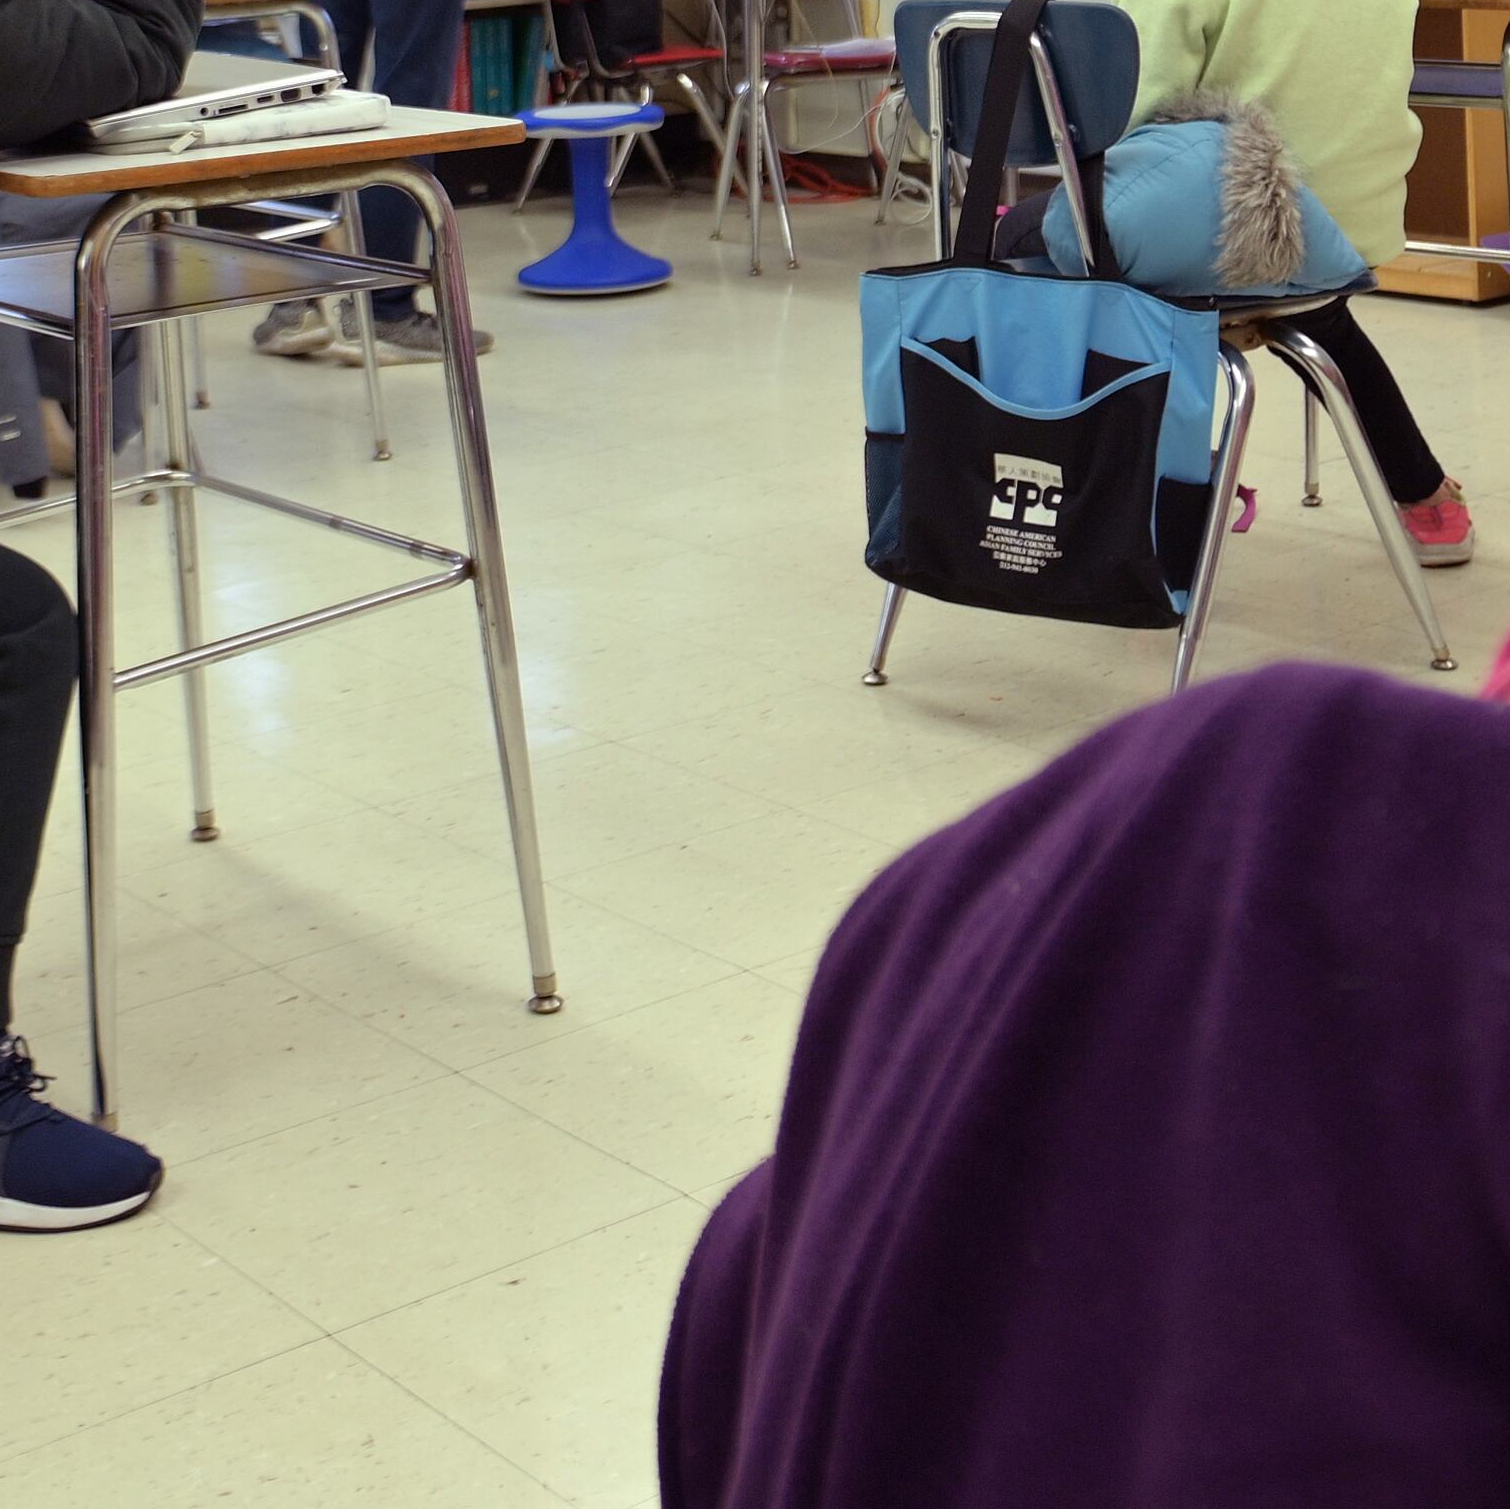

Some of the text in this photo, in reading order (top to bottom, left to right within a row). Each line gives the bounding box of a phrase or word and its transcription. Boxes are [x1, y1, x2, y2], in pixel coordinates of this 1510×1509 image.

[986, 533, 1023, 545] PLANNING
[987, 525, 1056, 542] CHINESE AMERICAN
[979, 540, 1062, 558] ASIAN FAMILY SERVICES
